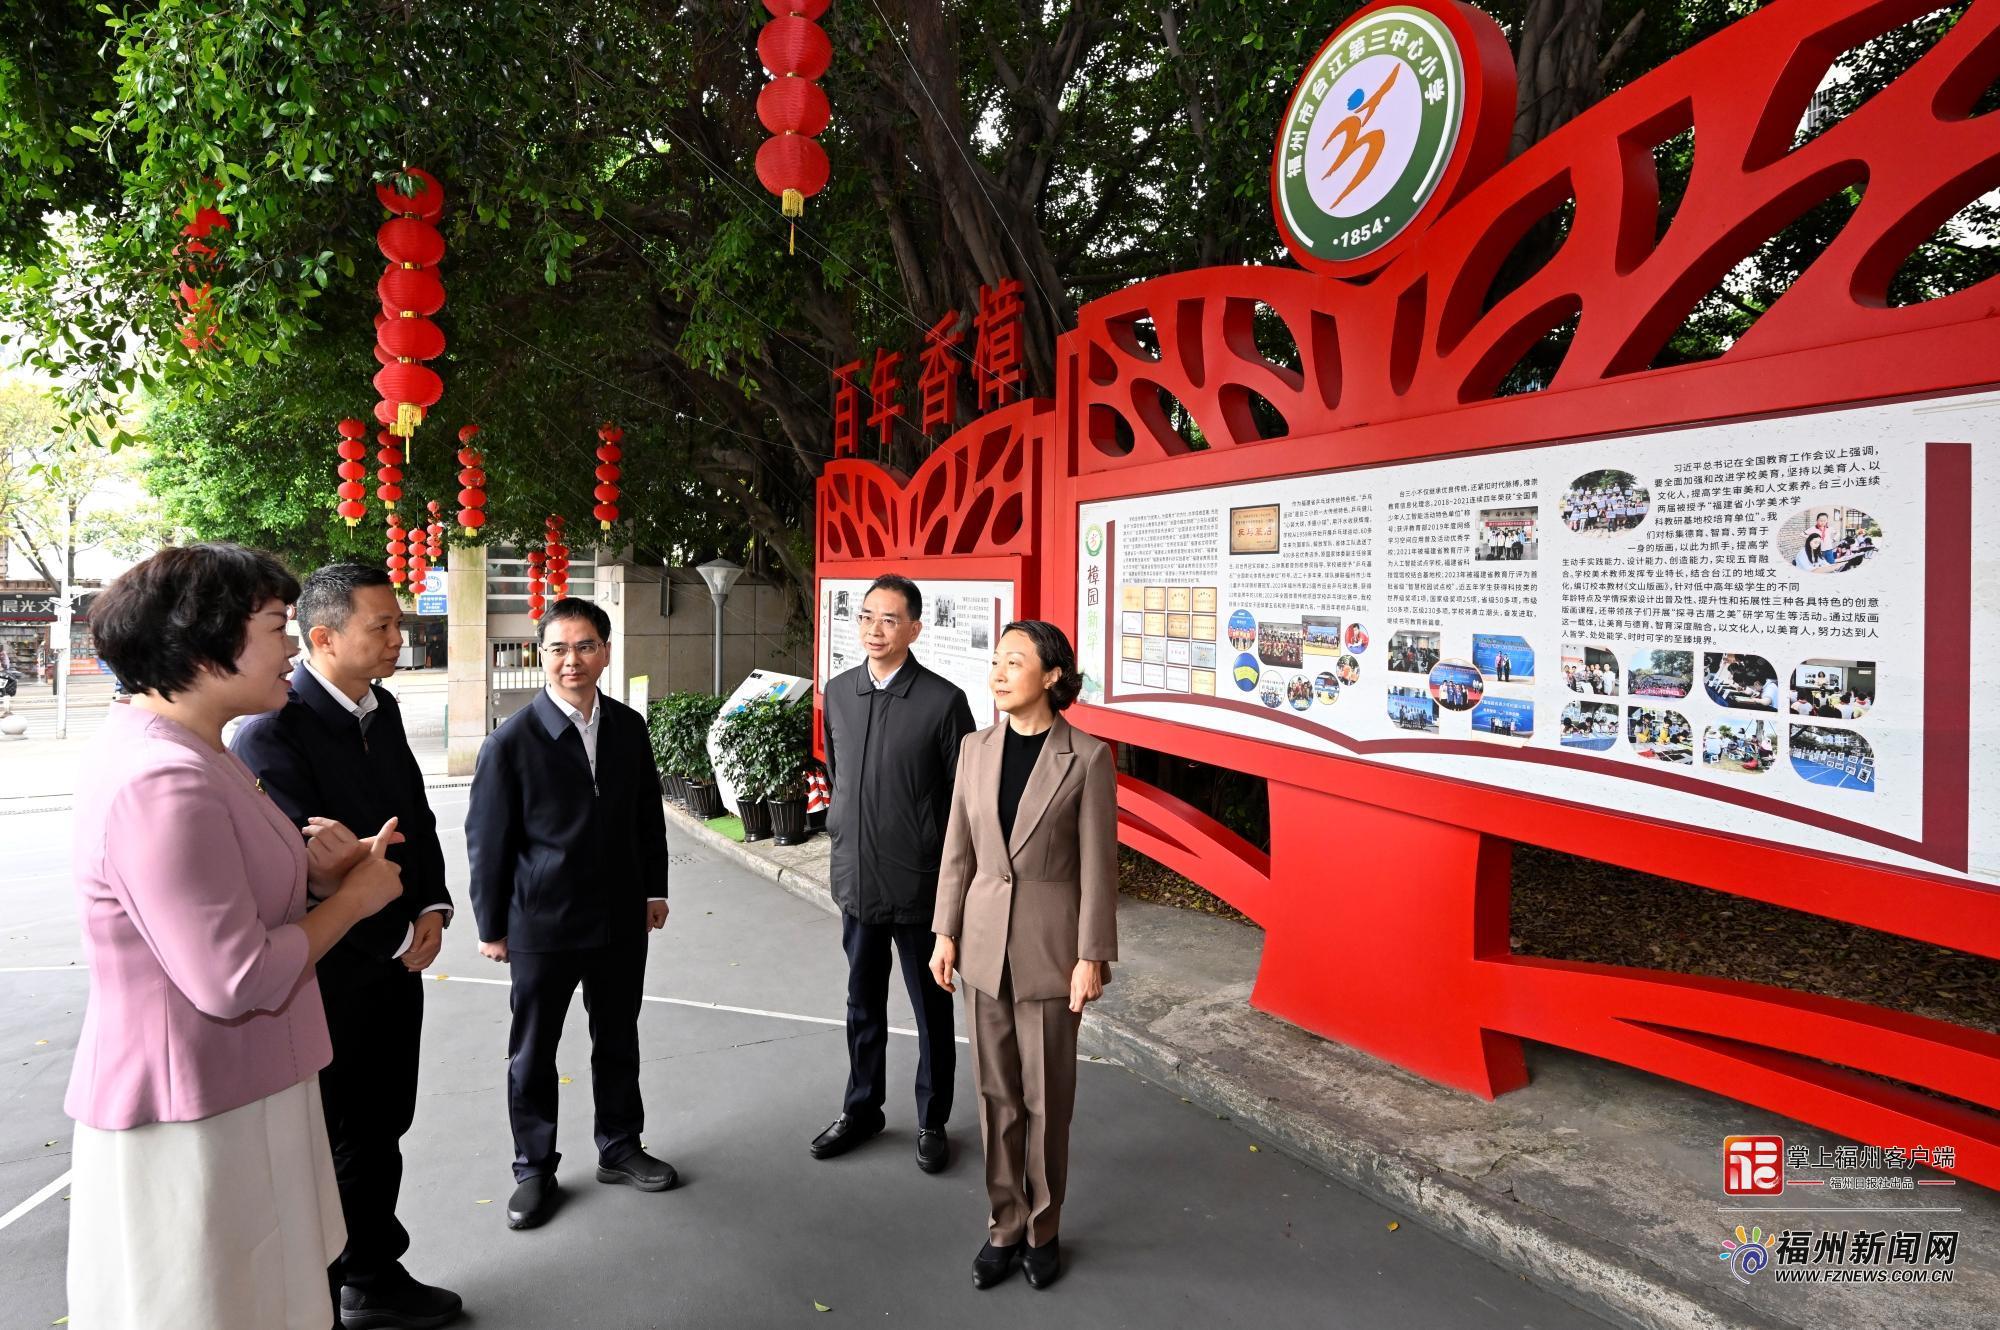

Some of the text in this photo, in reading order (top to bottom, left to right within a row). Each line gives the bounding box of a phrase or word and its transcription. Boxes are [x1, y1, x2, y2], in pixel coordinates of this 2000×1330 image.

[1287, 27, 1446, 178] 福州市台江第三中心小学
[832, 277, 1026, 458] 百年香樟
